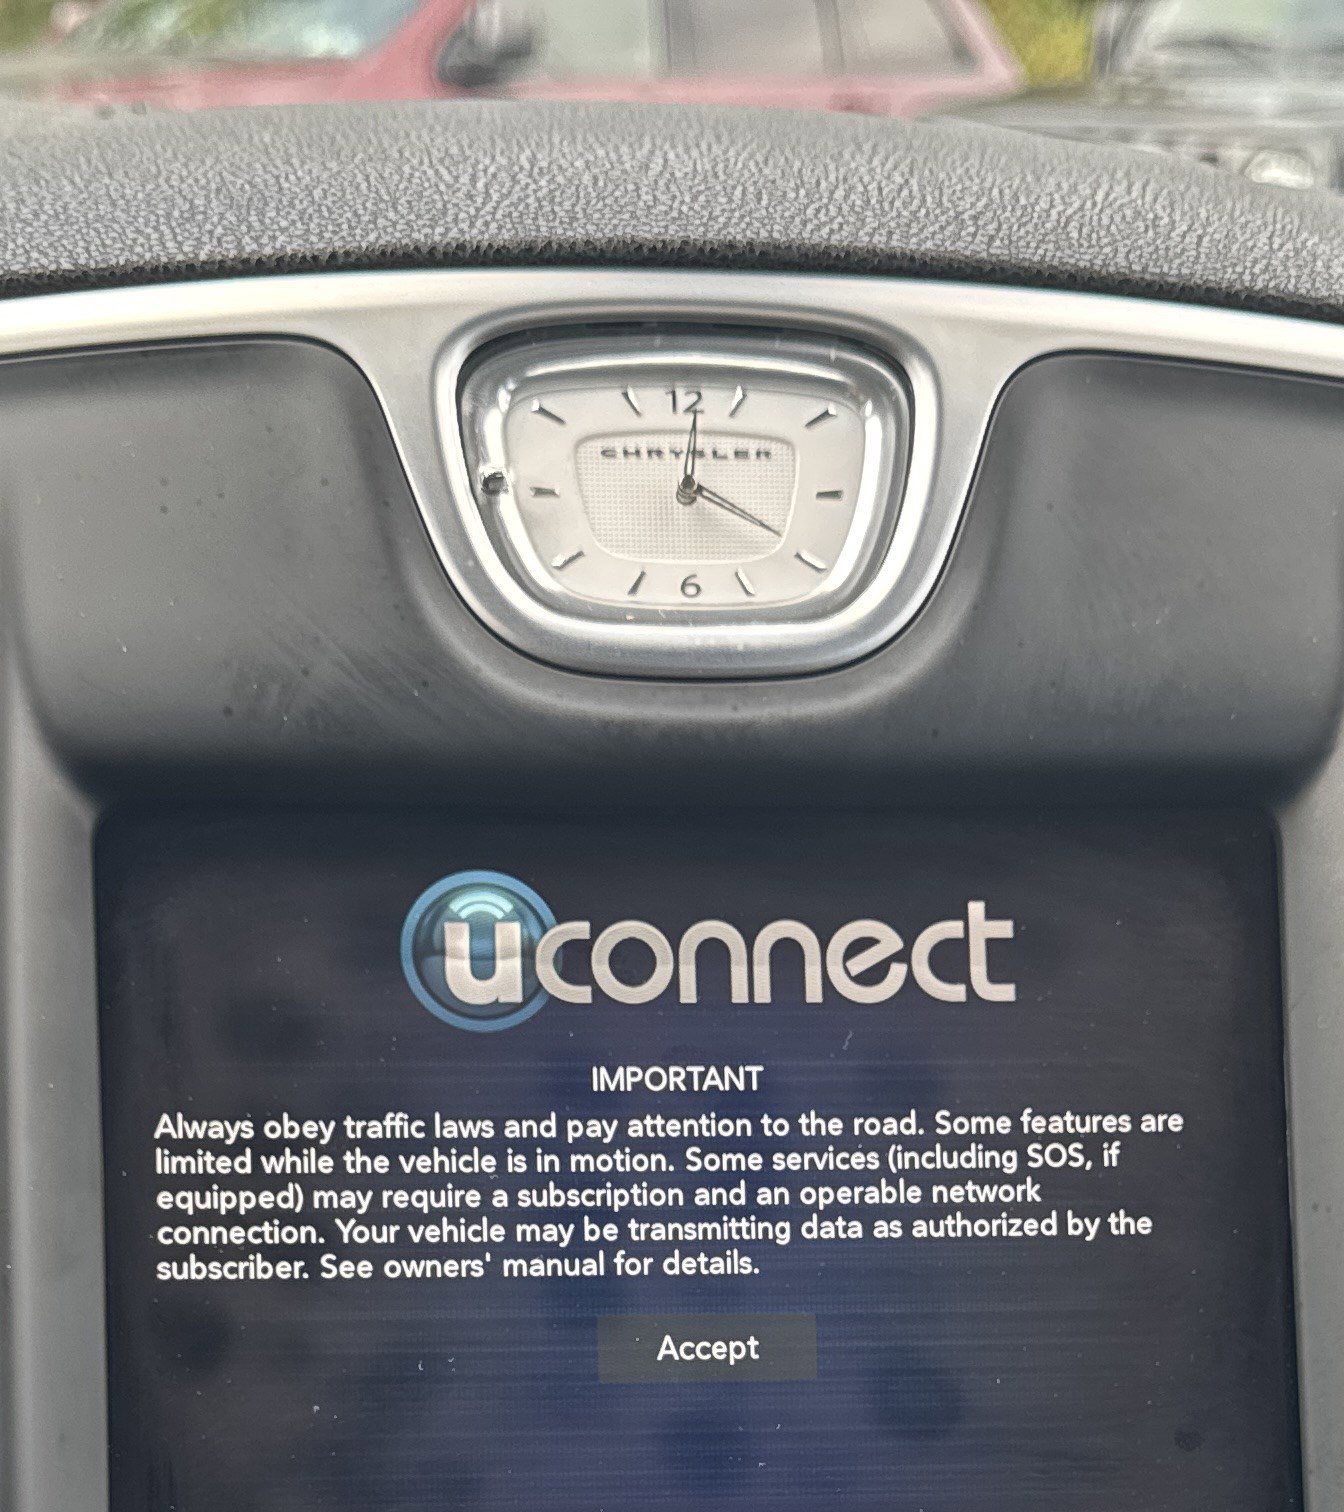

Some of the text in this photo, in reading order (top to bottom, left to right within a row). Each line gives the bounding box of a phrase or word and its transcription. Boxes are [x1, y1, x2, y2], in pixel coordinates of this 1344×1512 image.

[666, 387, 705, 414] 12
[600, 448, 773, 460] CHRYSLER
[680, 573, 703, 598] 6
[443, 900, 1017, 1005] uconnect
[592, 1065, 765, 1092] IMPORTANT
[154, 1108, 1184, 1145] Always obey traffic laws and pay attention to the road. Some features are
[156, 1141, 1122, 1174] limited while the vehicle is in motion. Some services (including SOS, if
[157, 1176, 1042, 1215] equipped) may require a subscription and an operable network
[158, 1209, 1153, 1248] connection. Your vehicle may be transmitting data as authorized by the
[157, 1247, 760, 1280] subscriber. See owners' manual for details.
[656, 1334, 760, 1366] Accept
